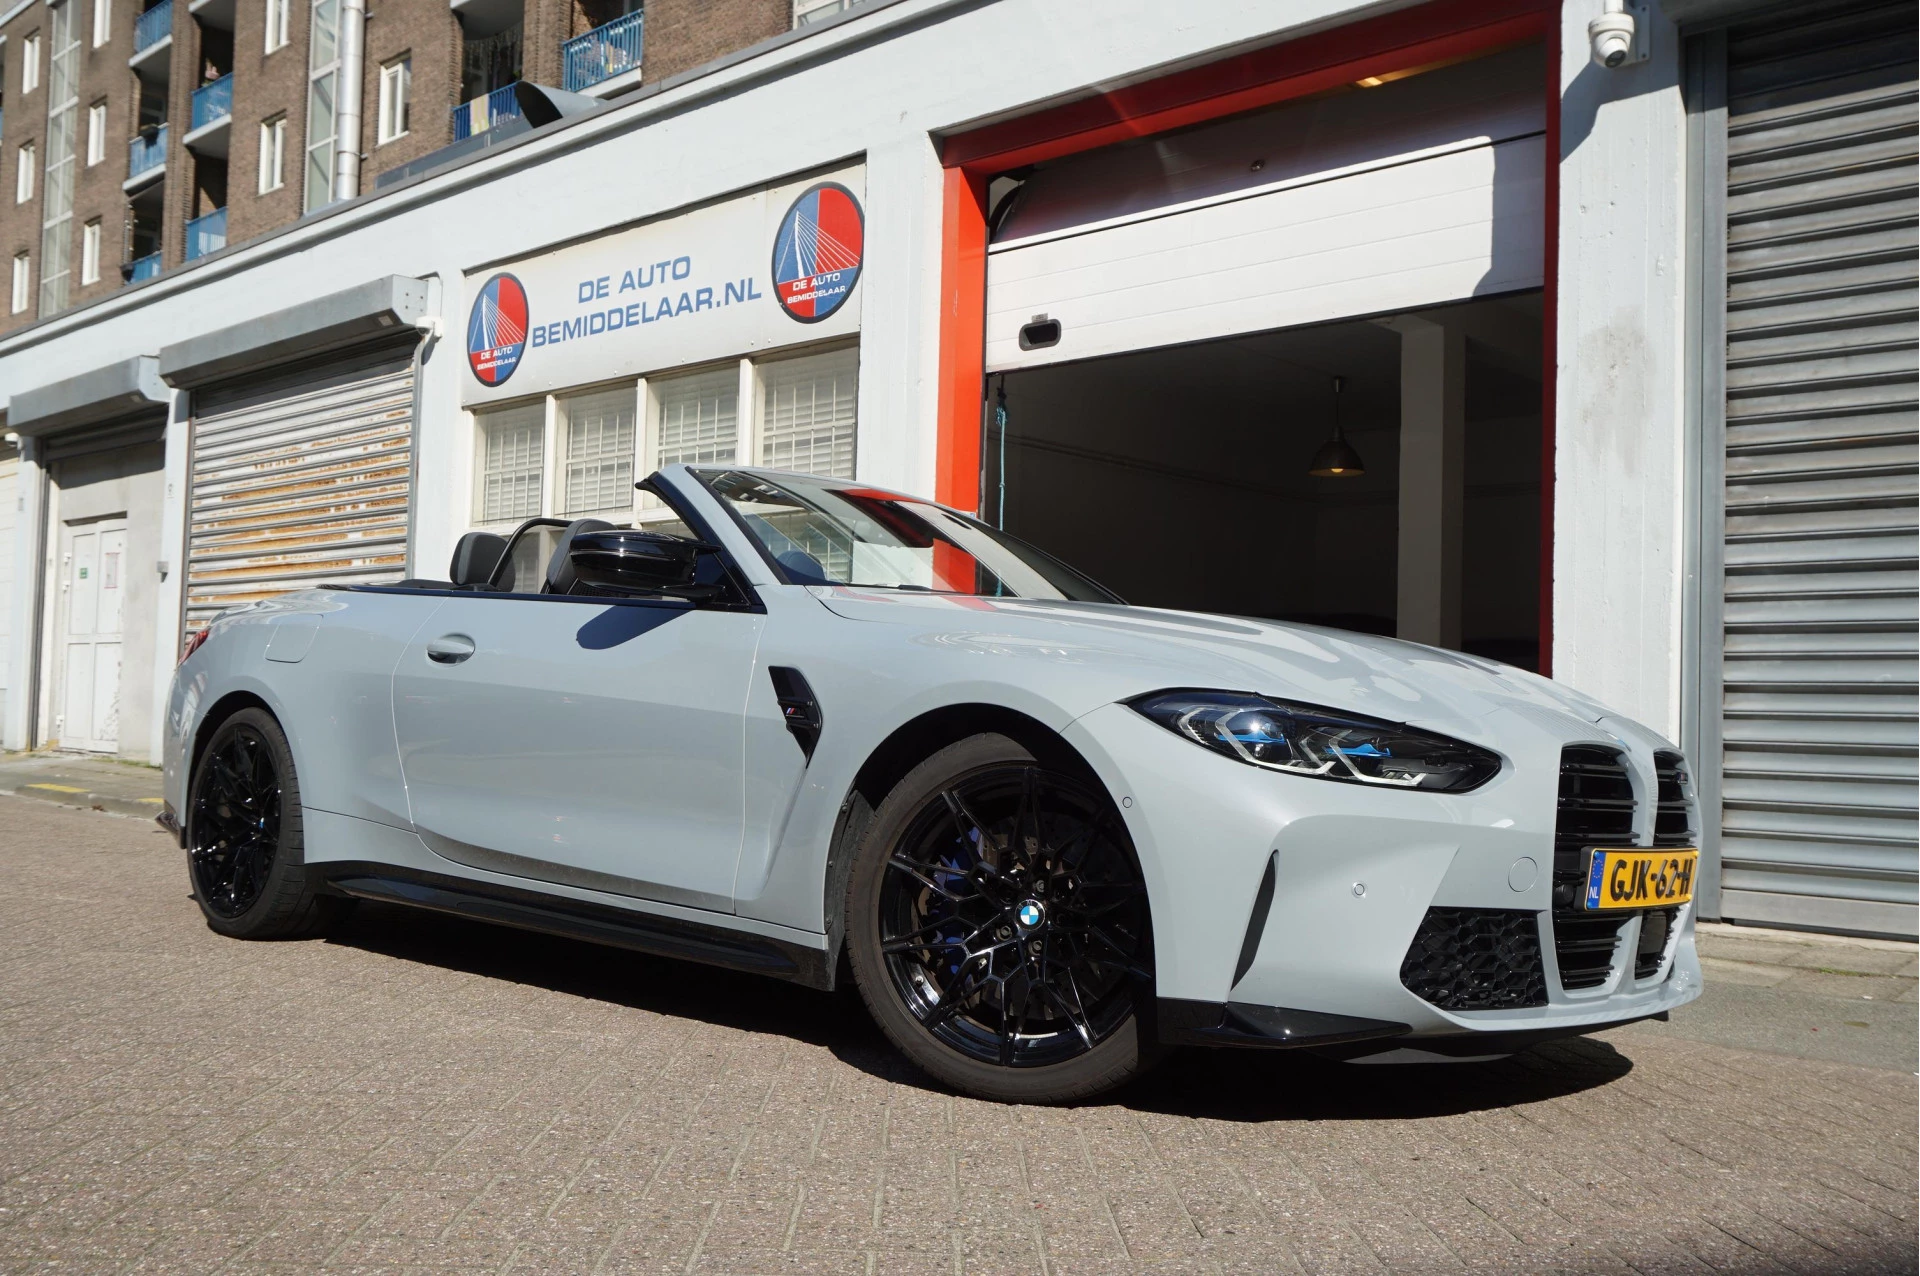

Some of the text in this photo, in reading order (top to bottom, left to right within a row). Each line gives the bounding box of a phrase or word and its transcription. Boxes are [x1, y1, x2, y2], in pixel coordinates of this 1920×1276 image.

[578, 255, 692, 304] DE AUTO
[792, 272, 841, 291] DE AUTO
[786, 285, 846, 304] BEMIDDELAAR
[532, 276, 763, 348] BEMIDDELAAR.NL
[480, 346, 513, 360] DE AUTO
[1610, 858, 1694, 902] GJK-62-H
[1588, 886, 1599, 899] NL
